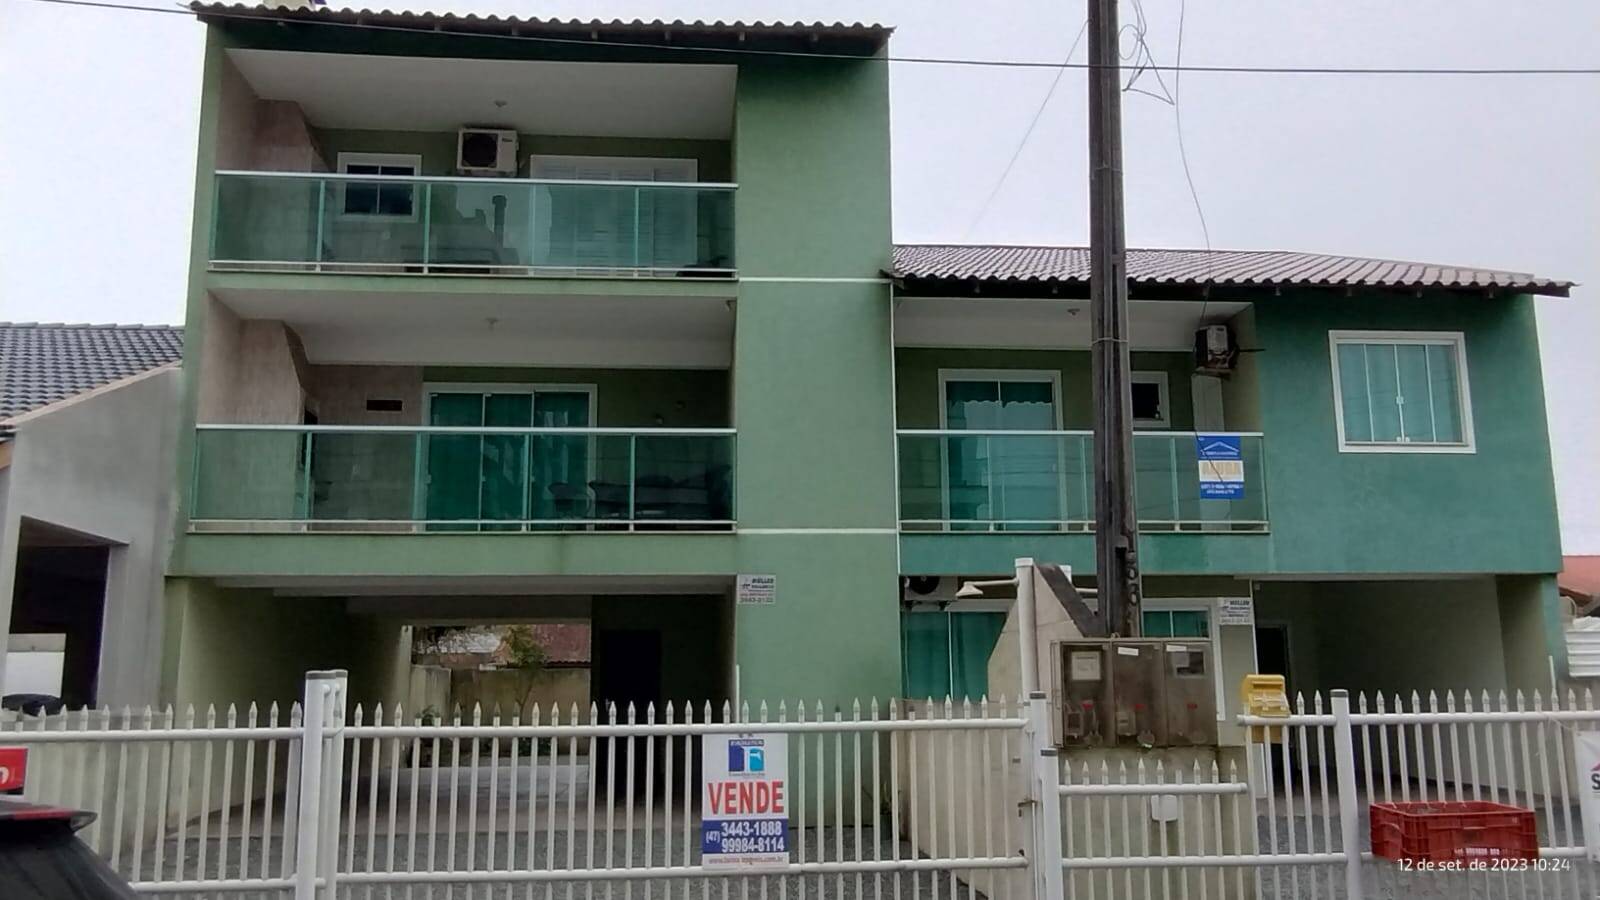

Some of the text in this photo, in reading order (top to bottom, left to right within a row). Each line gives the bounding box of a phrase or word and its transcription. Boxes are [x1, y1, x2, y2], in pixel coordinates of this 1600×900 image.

[708, 781, 785, 815] VENDE
[706, 821, 783, 844] (47) 3443-1888
